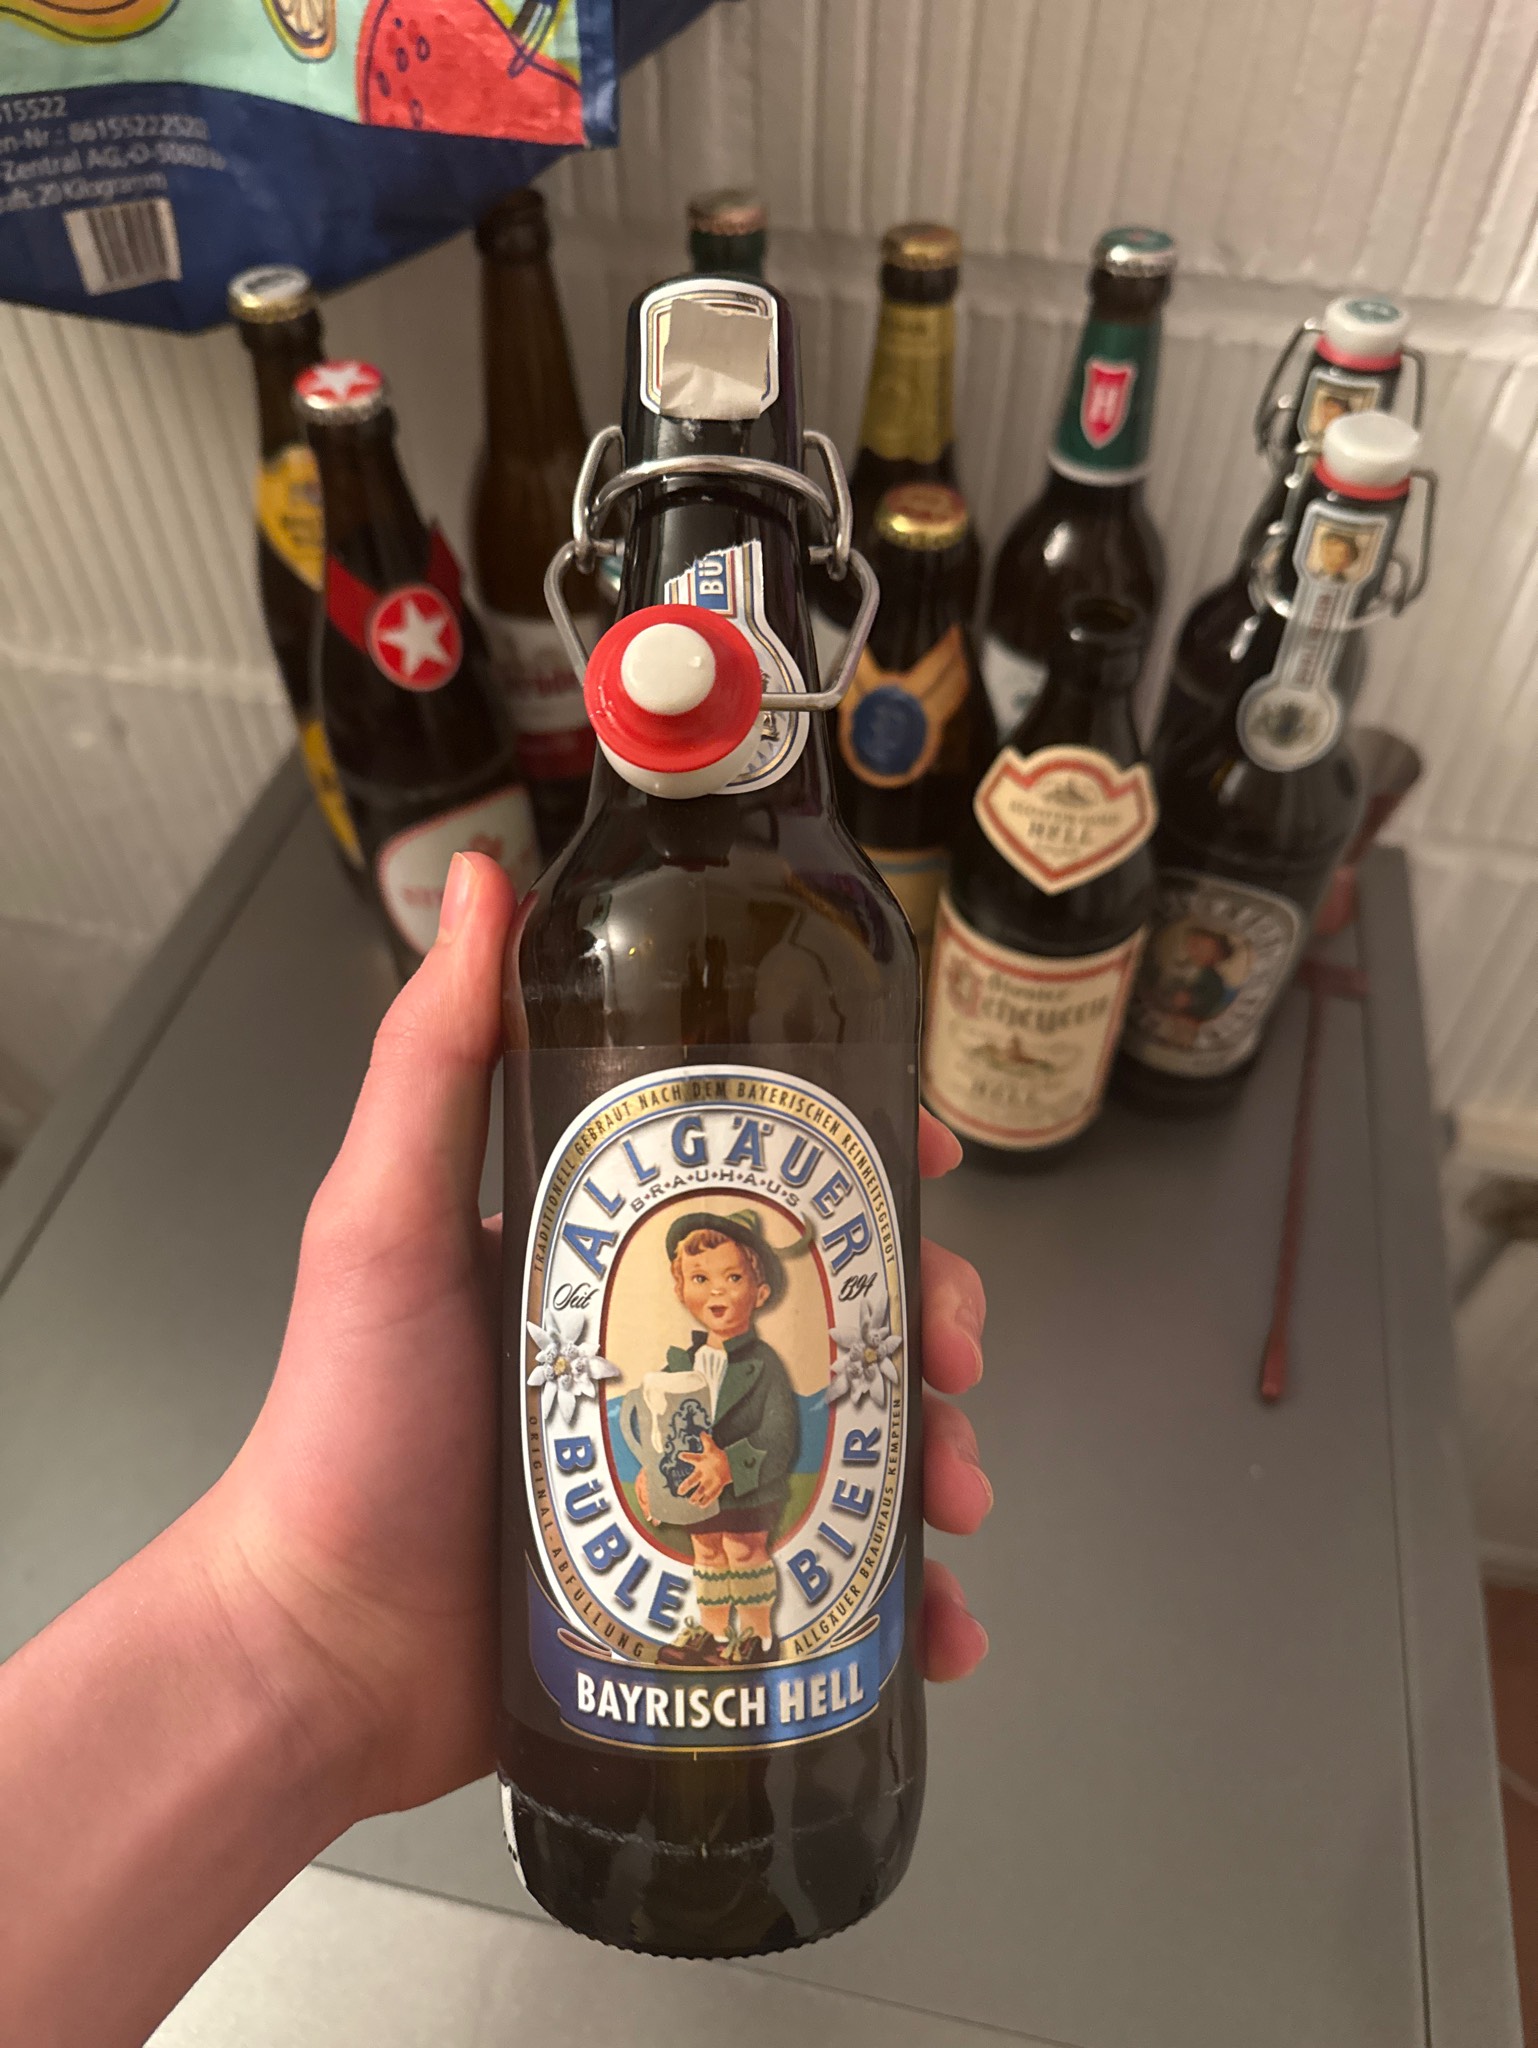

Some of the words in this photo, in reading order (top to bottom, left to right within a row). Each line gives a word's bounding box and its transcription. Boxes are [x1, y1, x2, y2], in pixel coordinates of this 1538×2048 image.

[698, 552, 725, 595] BÜ
[534, 1157, 576, 1272] TRADITIONELL
[574, 1102, 632, 1156] GEBRAUT
[638, 1084, 682, 1111] NACH
[692, 1080, 727, 1098] DEM
[737, 1081, 841, 1138] BAYERISCHEN
[840, 1133, 896, 1264] REINHEITSGEBOT
[562, 1114, 874, 1280] ALLGÄUER
[552, 1282, 600, 1311] Seit
[553, 1434, 690, 1630] BÜBLE
[786, 1426, 882, 1604] BIER
[793, 1584, 861, 1656] ALLGÄUER
[859, 1486, 895, 1579] BRAUHAUS
[887, 1398, 902, 1476] KEMPTEN
[576, 1670, 767, 1729] BAYRISCH
[778, 1661, 865, 1724] HELL
